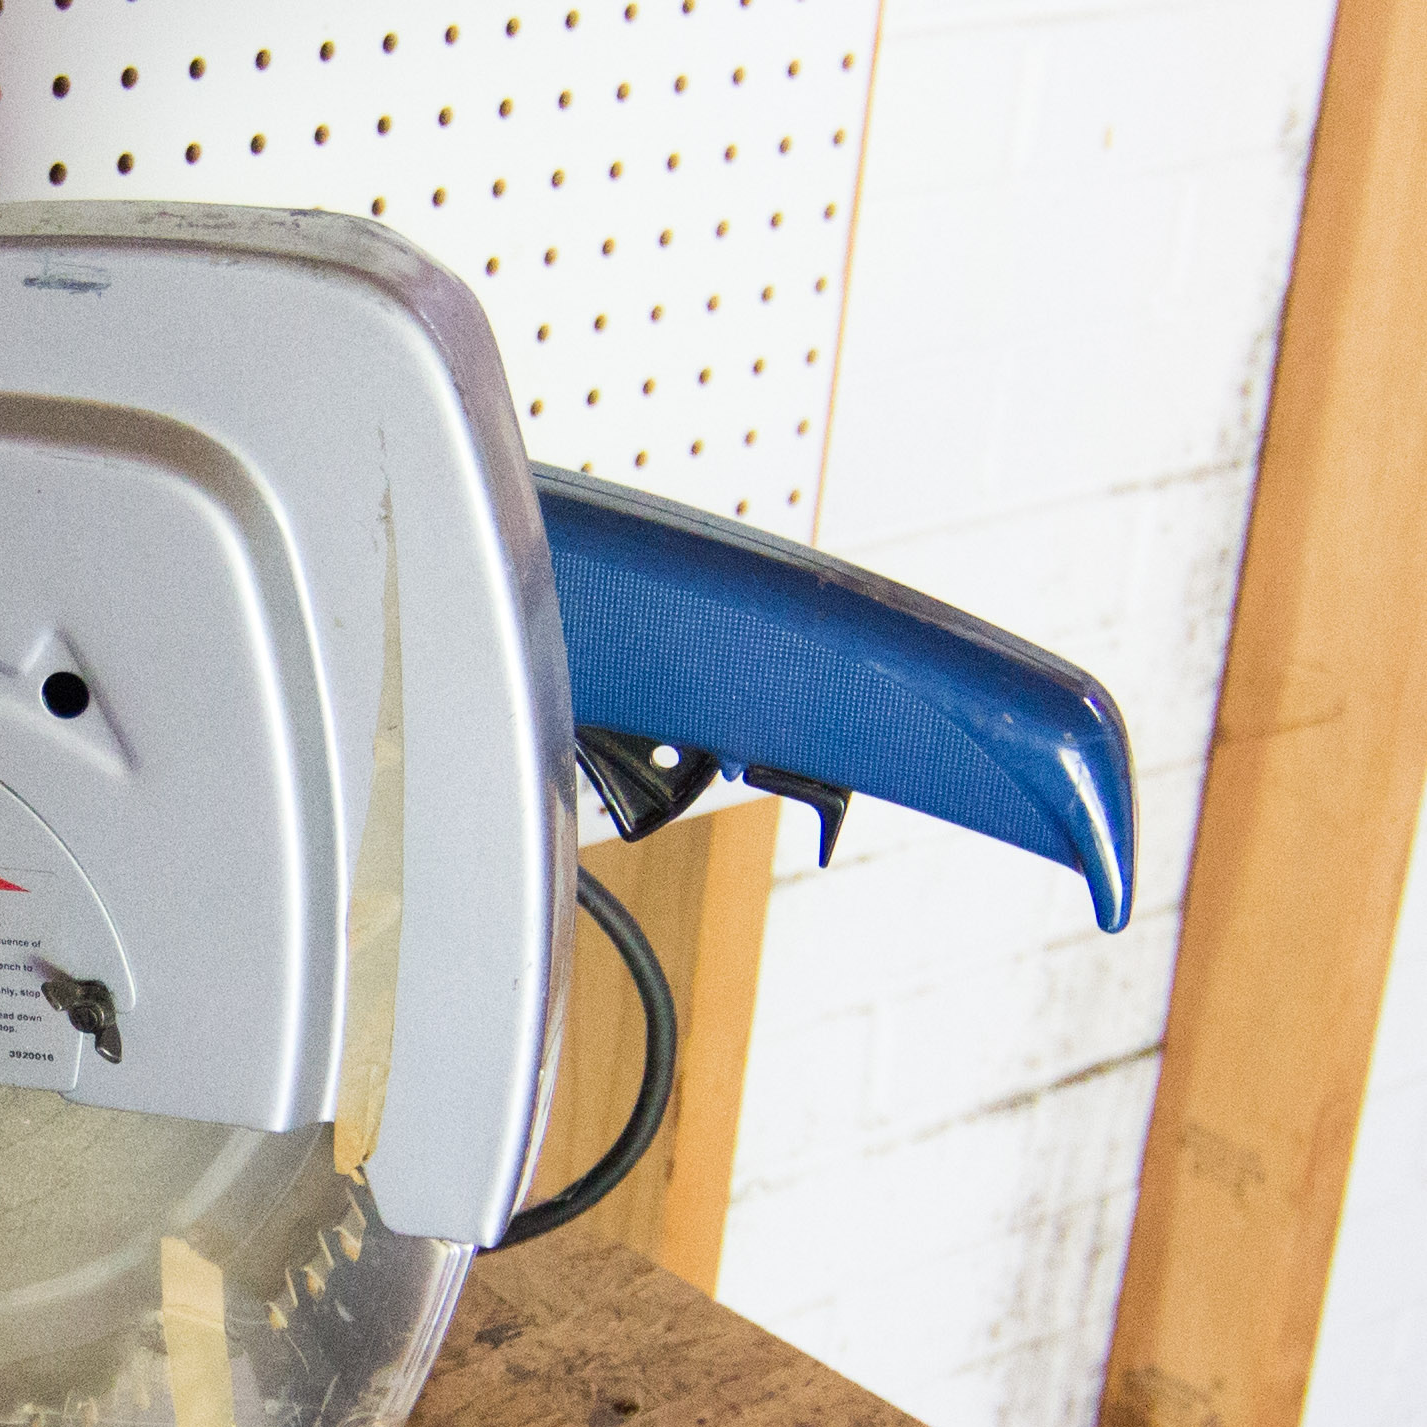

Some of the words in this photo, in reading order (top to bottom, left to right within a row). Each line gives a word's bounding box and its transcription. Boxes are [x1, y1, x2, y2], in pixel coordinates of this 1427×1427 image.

[31, 939, 40, 947] of
[23, 963, 32, 971] to
[20, 988, 40, 997] stop
[17, 1012, 41, 1020] down
[8, 1050, 54, 1062] 3920016
